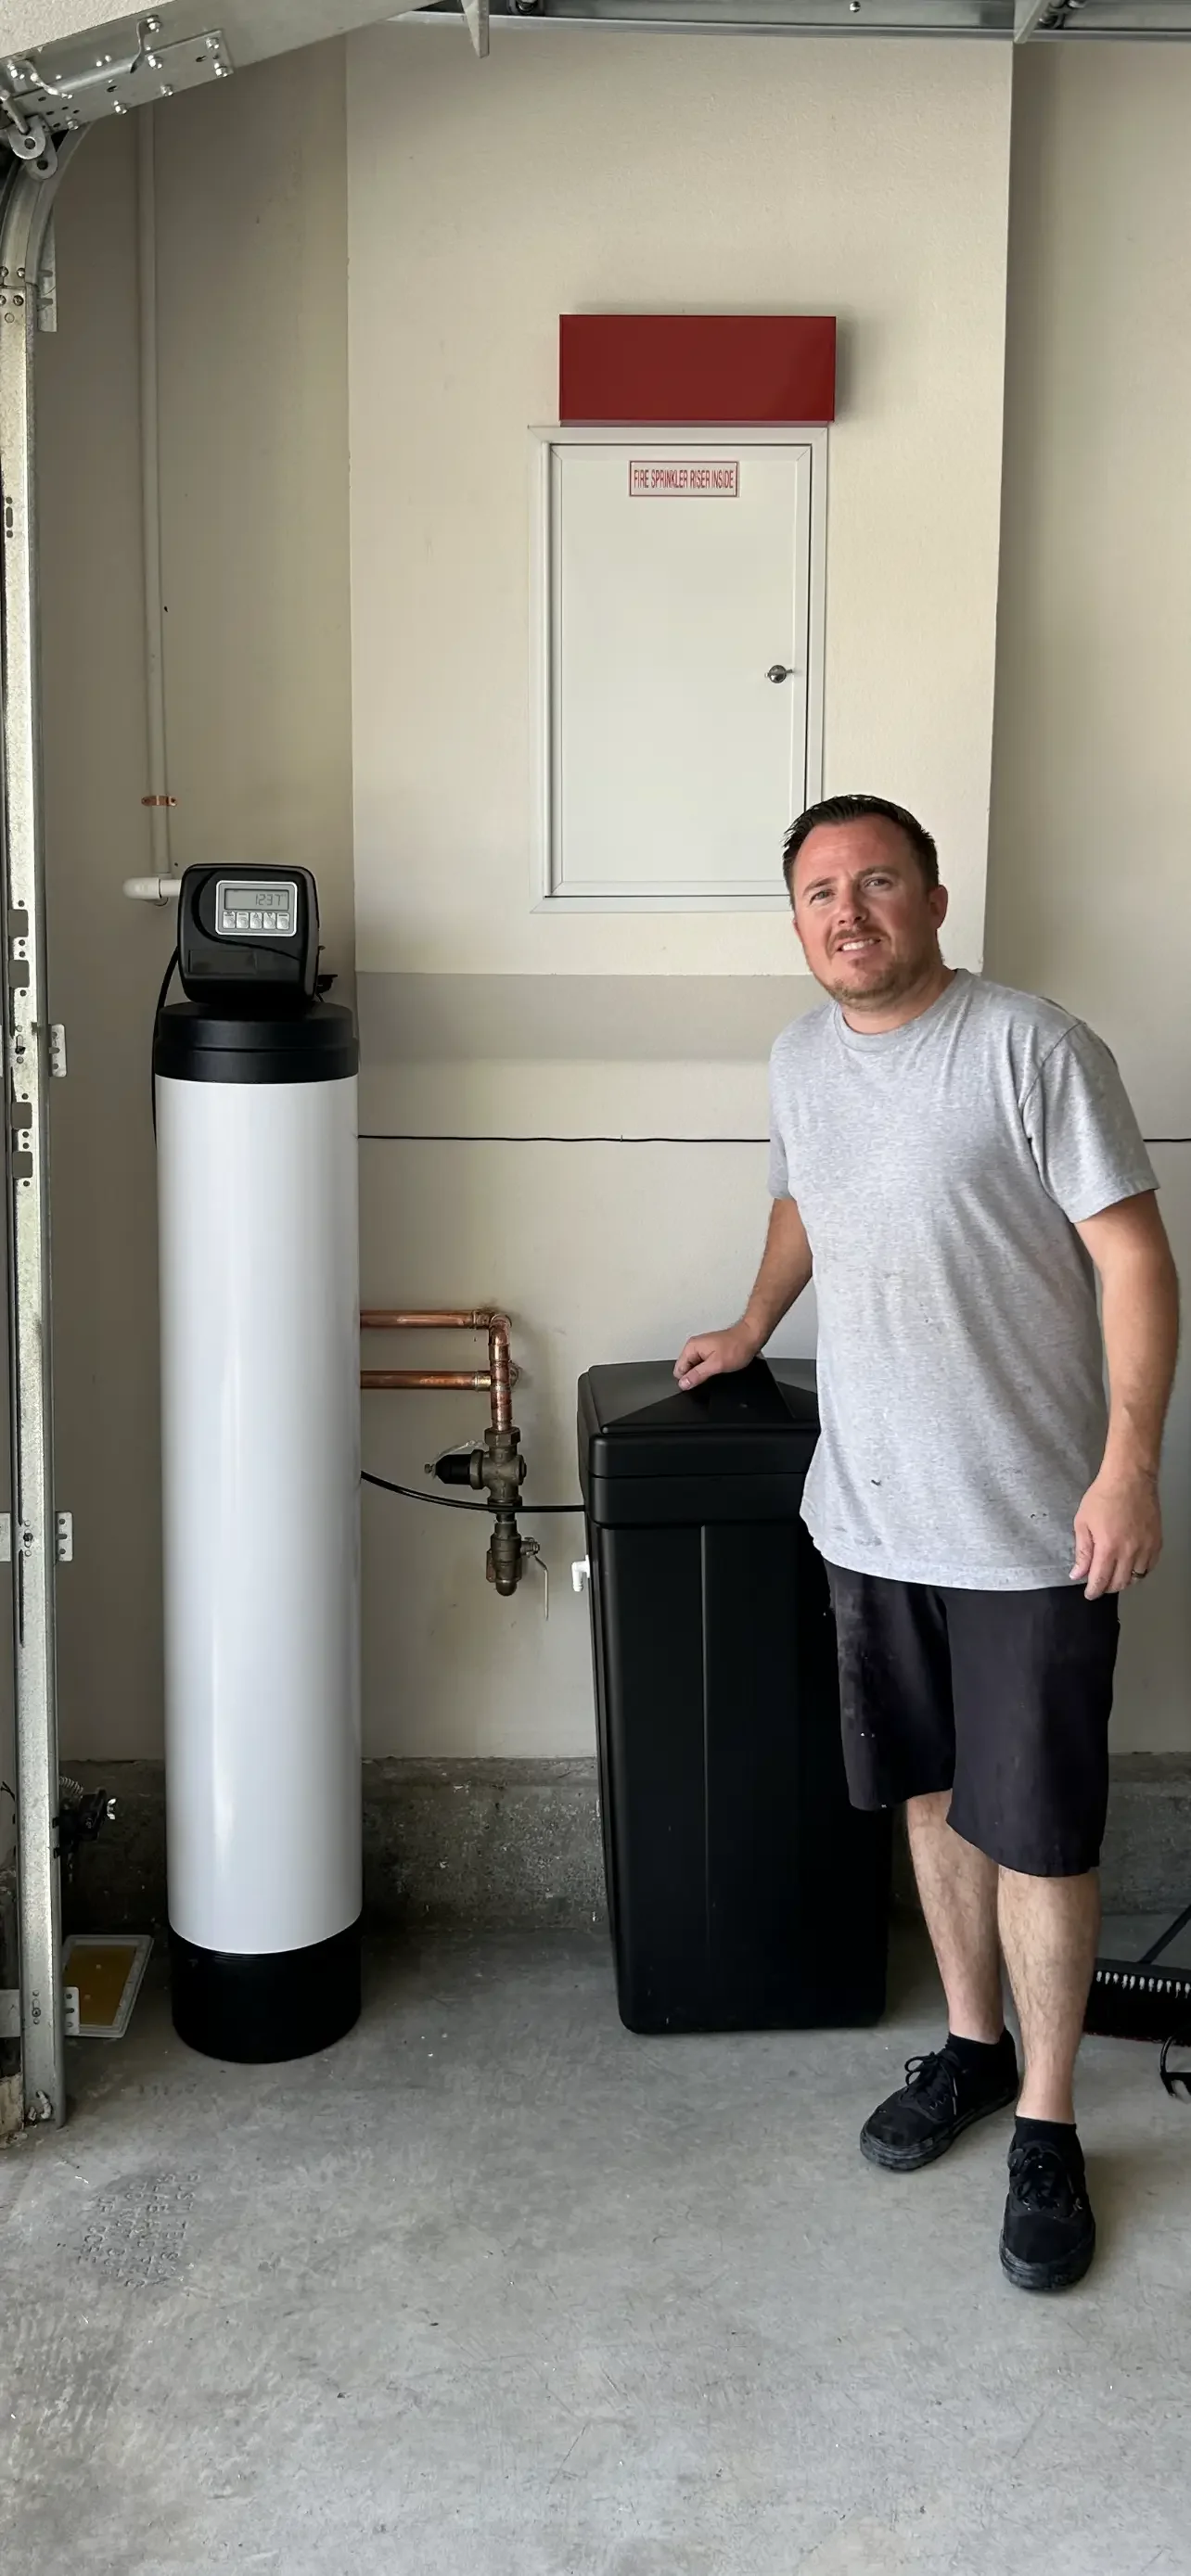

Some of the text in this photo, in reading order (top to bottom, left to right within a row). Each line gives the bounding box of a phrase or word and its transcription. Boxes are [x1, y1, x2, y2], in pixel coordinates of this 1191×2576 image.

[634, 469, 734, 489] FIRE SPRINKLER RISER INSIDE
